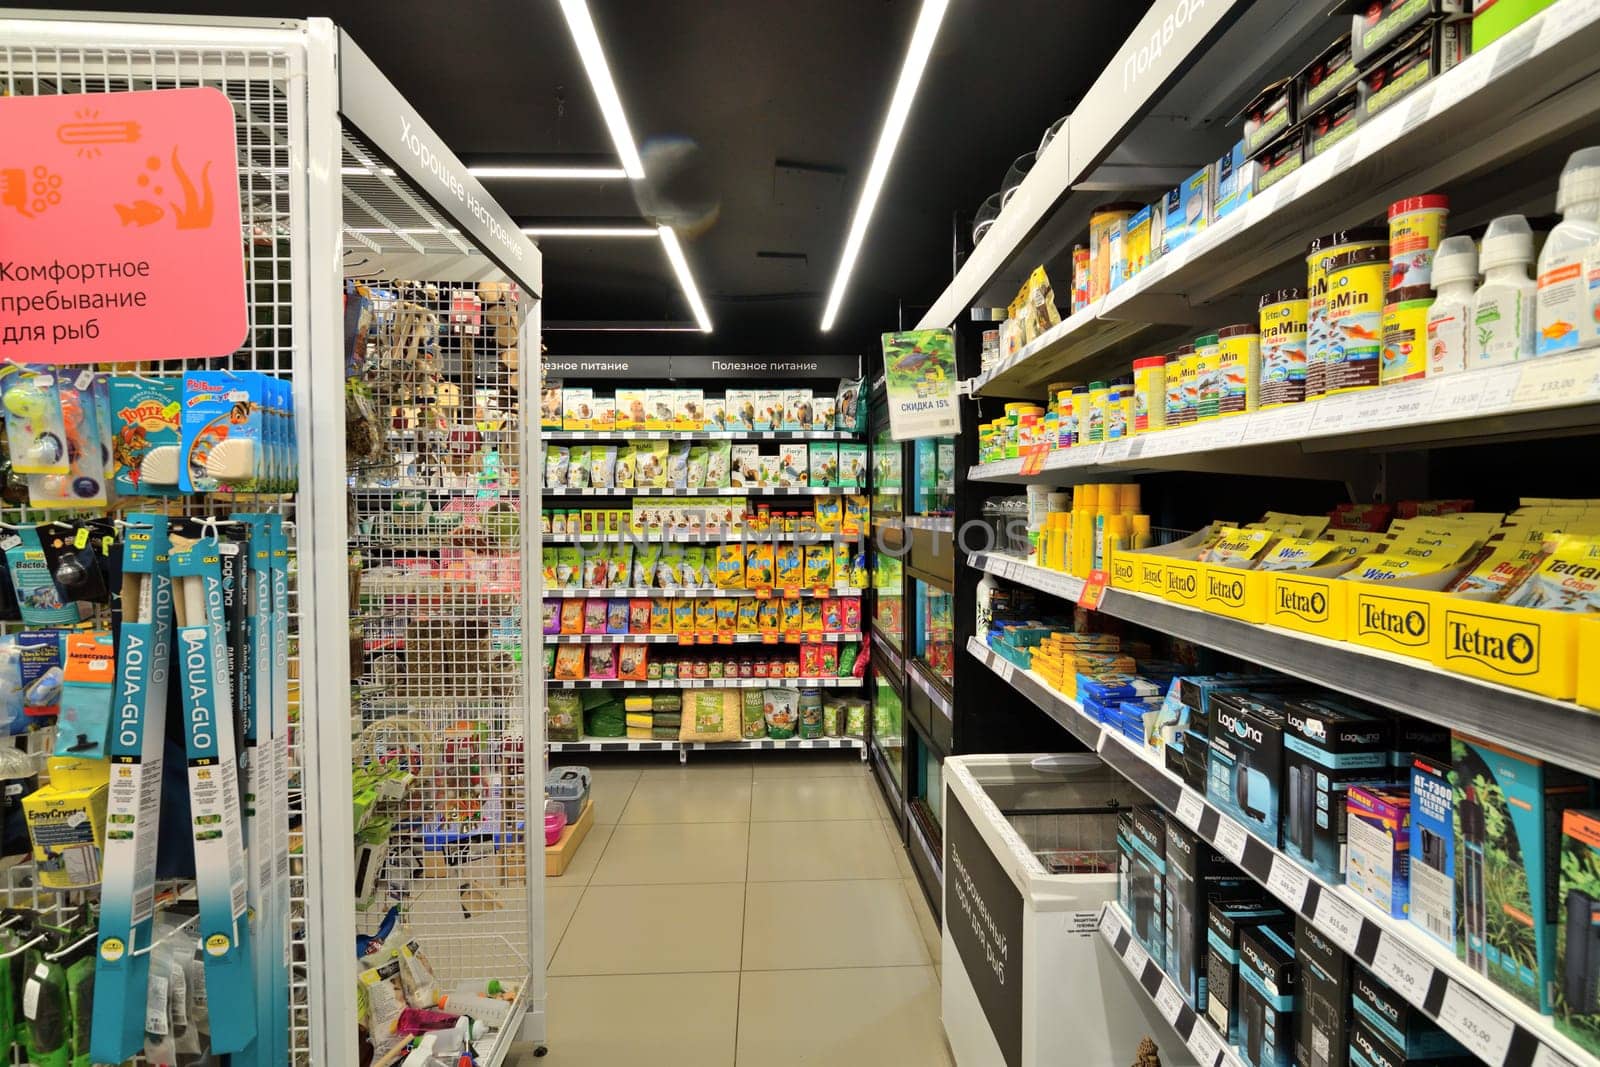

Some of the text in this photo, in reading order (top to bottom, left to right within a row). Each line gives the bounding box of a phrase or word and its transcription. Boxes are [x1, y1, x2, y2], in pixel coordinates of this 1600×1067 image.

[400, 115, 522, 261] Хорошее настроение
[0, 259, 150, 285] Комфортное
[1, 290, 147, 316] пребывание
[2, 318, 100, 345] для рыб
[580, 362, 628, 370] питание
[712, 361, 817, 371] Полезное питание
[901, 399, 950, 412] СКИДКА 15%
[718, 560, 740, 571] RIO
[152, 574, 171, 684] AQUA-GLO
[207, 577, 226, 685] AQUA-GLO
[257, 570, 269, 673] AQUA-GLO
[274, 568, 287, 668] AQUA-GLO
[119, 634, 143, 747] AQUA-GLO
[186, 640, 212, 749] AQUA-GLO
[951, 843, 1008, 960] Замороженный
[955, 877, 1005, 985] корм для рыб
